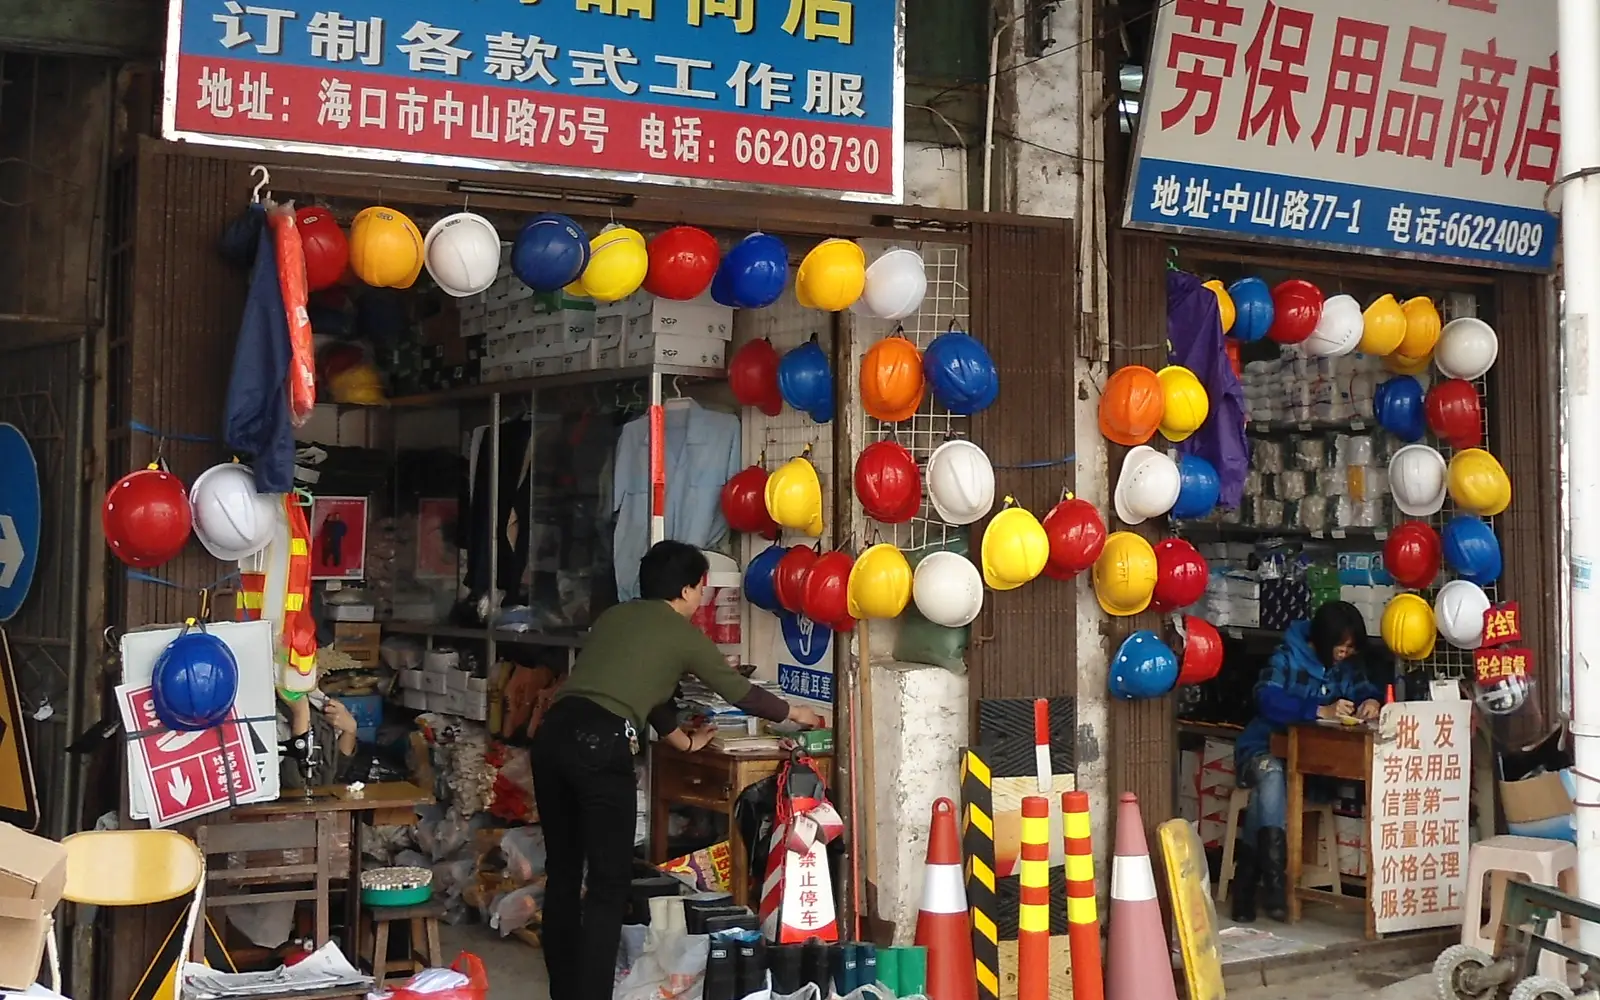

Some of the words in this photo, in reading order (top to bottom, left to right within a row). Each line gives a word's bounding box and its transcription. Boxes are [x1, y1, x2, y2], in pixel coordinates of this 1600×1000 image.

[212, 1, 867, 118] 订制各款式工作服
[1160, 0, 1563, 186] 劳保用品商店
[1386, 202, 1544, 258] 电话:66224089
[780, 667, 831, 699] 必须戴耳塞
[1476, 654, 1526, 681] 安全监督
[1396, 713, 1455, 750] 批发
[1383, 753, 1461, 784] 劳保用品
[1381, 786, 1460, 817] 信誉第一
[1380, 819, 1460, 850] 质量保证
[1381, 851, 1460, 885] 价格合理
[798, 852, 819, 927] 禁止停车
[1379, 884, 1460, 920] 服务至上
